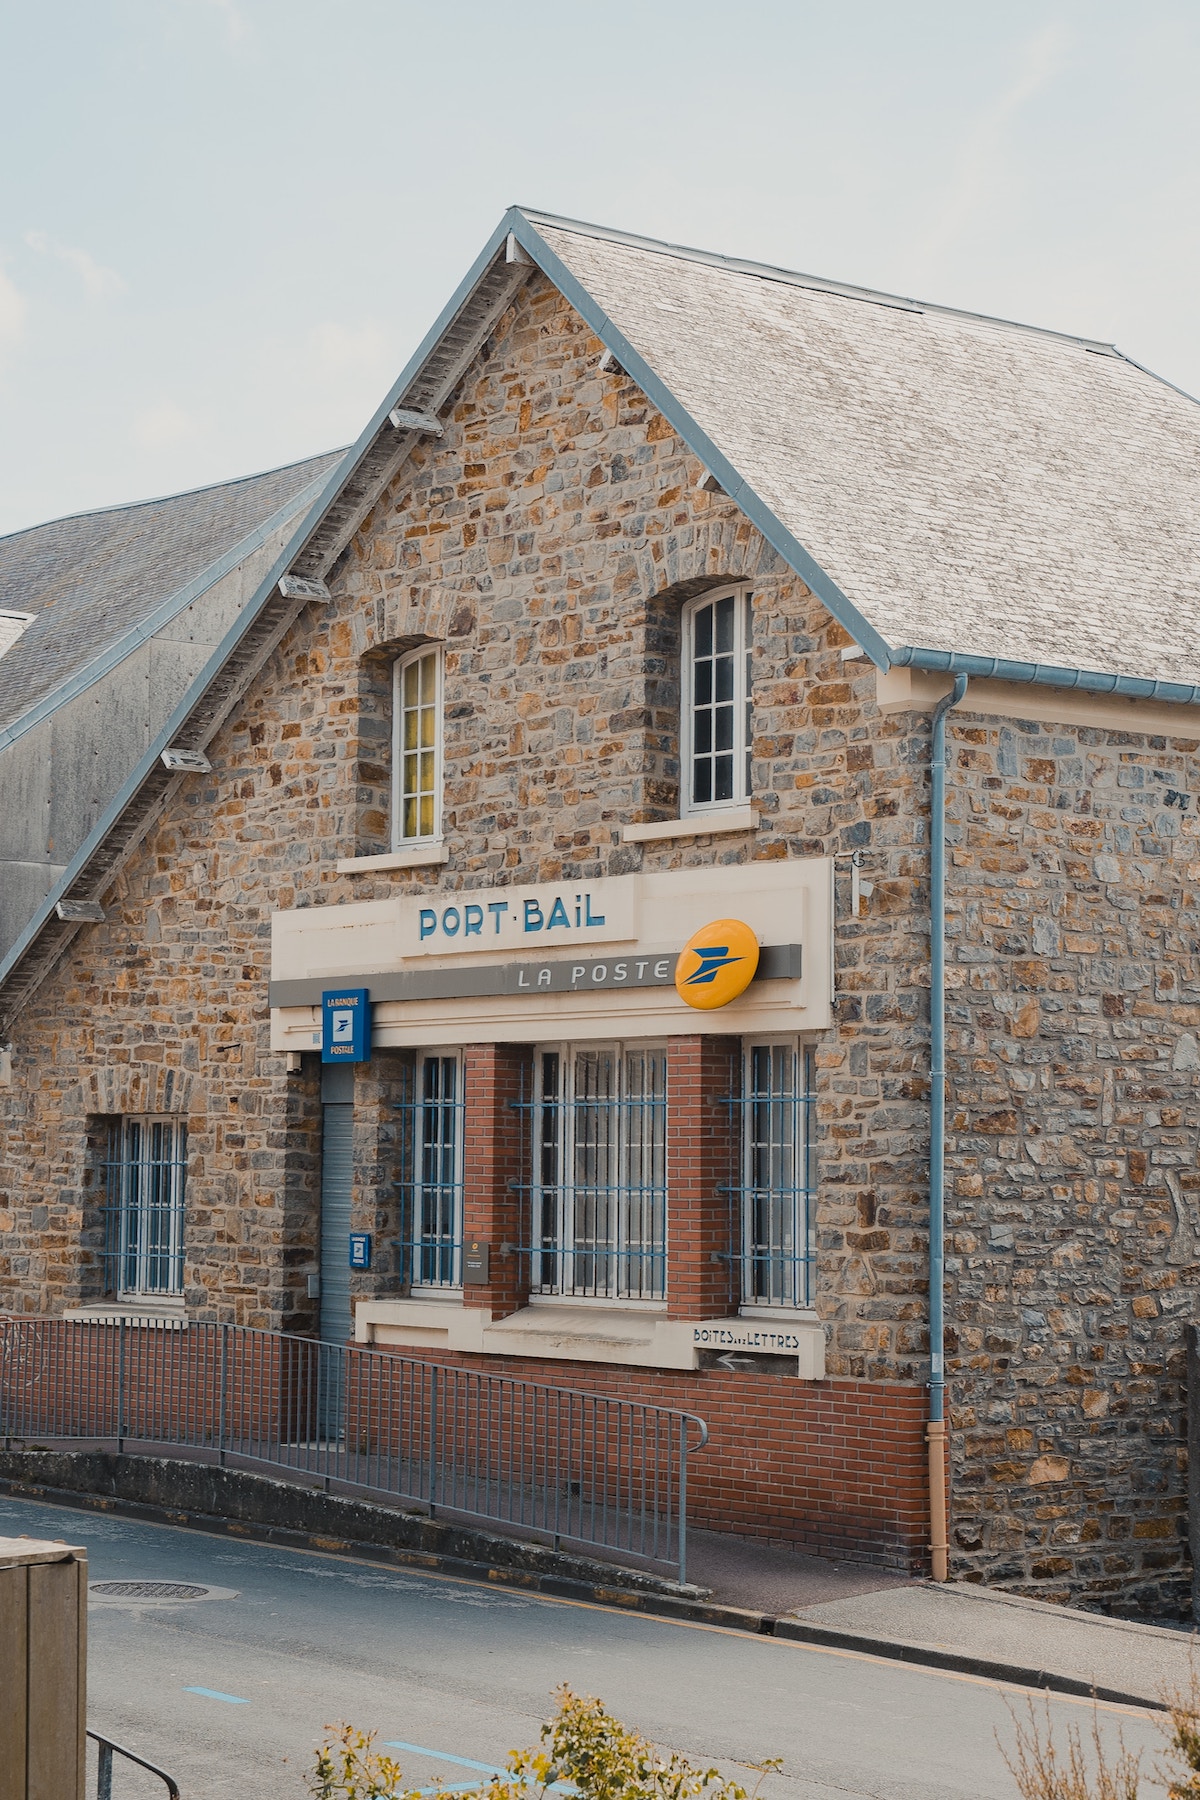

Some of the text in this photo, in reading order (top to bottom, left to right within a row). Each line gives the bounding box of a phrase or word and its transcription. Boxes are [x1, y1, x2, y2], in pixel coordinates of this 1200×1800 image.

[518, 961, 670, 986] LA POSTE
[328, 999, 335, 1007] LA
[747, 1333, 799, 1348] LETTRES
